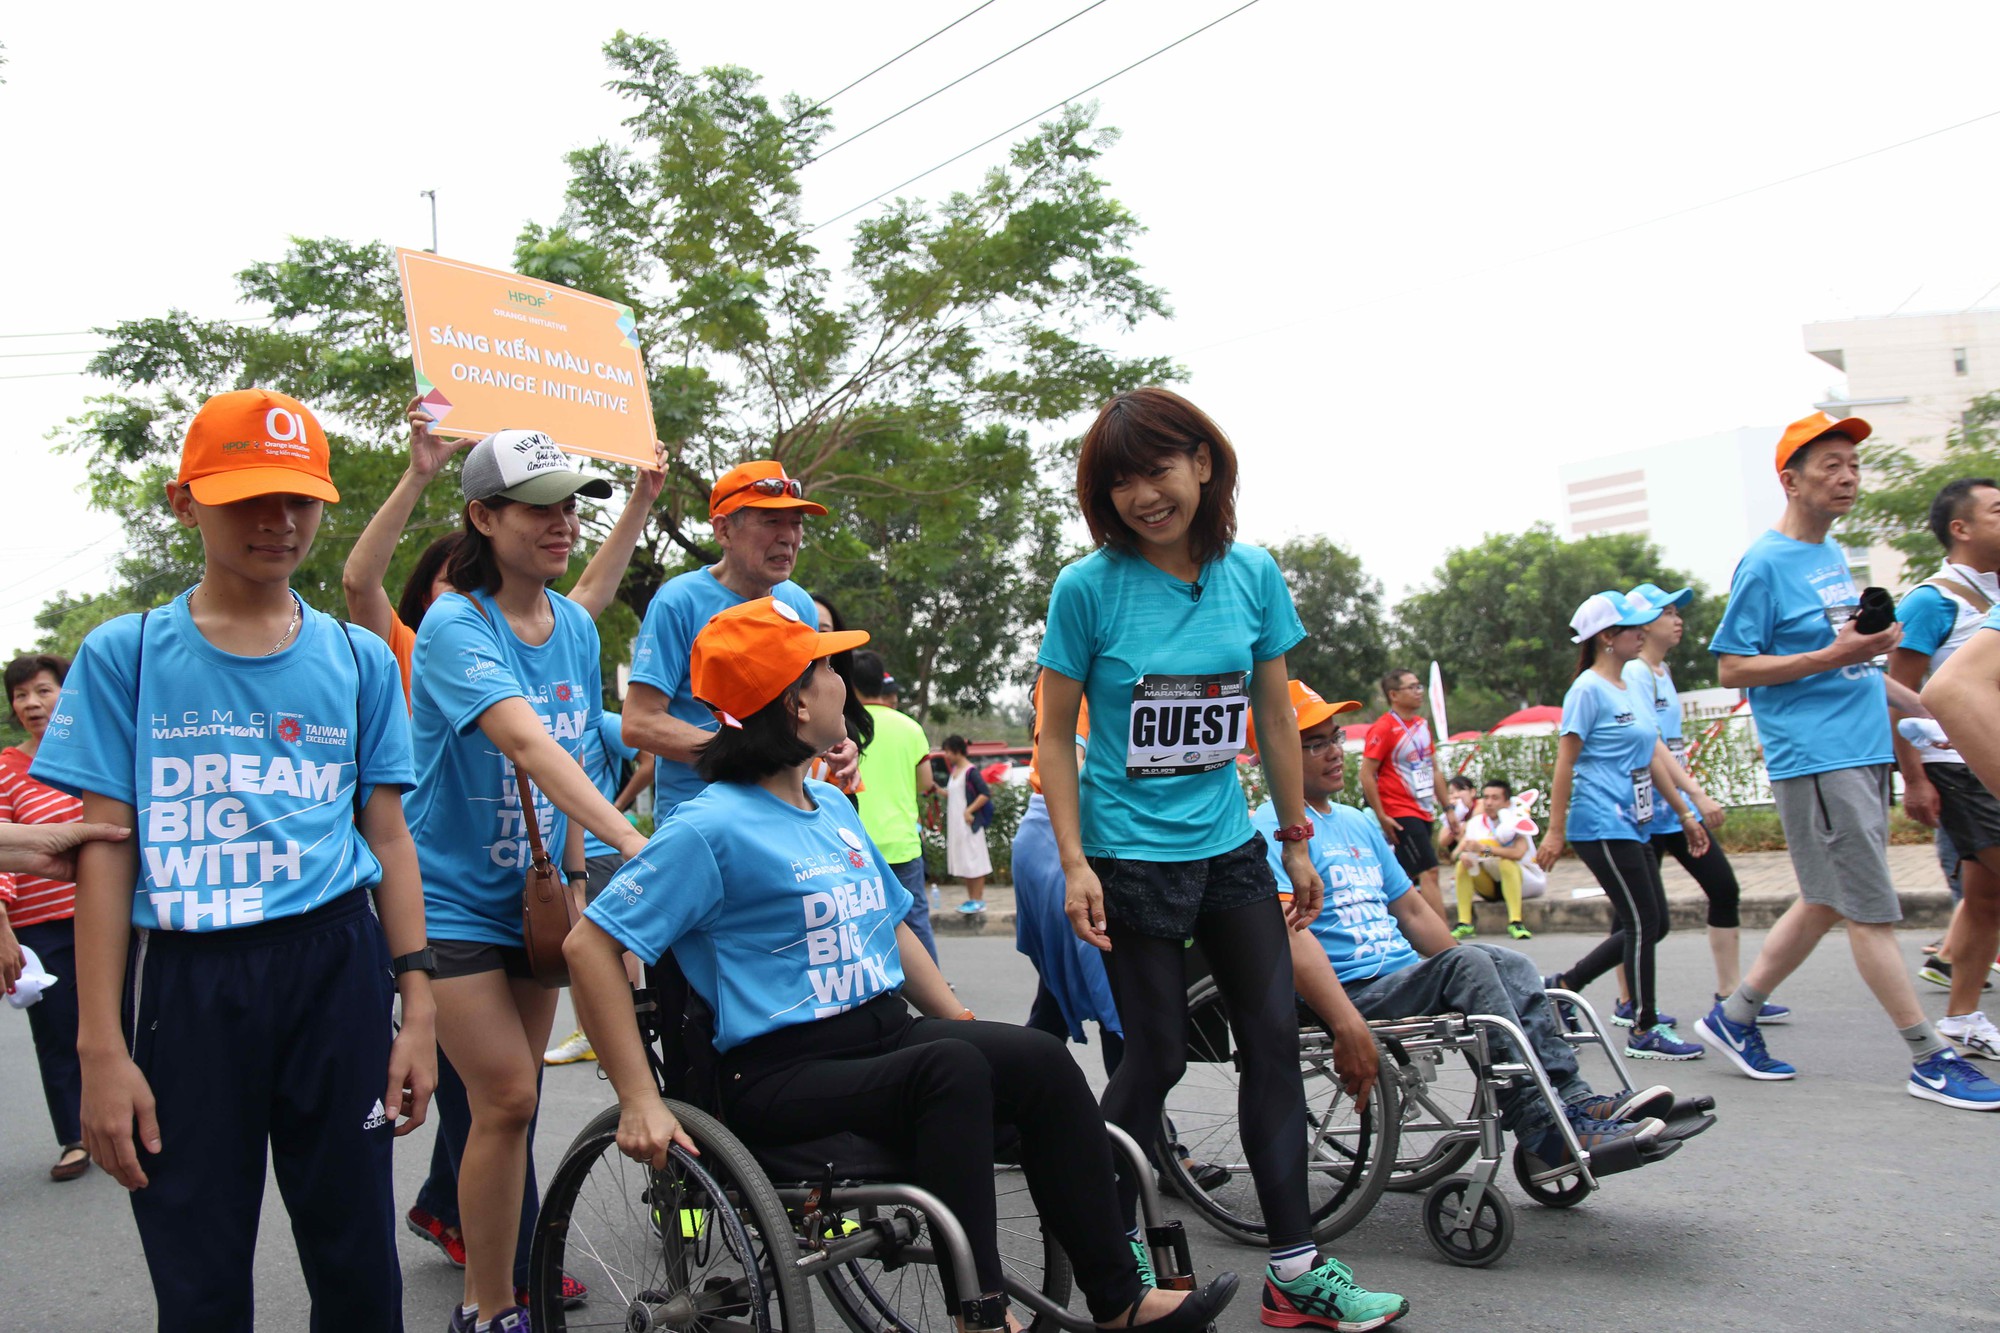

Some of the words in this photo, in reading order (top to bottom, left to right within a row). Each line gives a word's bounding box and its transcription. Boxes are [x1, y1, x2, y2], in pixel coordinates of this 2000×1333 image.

[493, 308, 529, 322] ORANGE
[529, 316, 568, 332] INITIATIVE
[508, 290, 546, 307] HPDF
[429, 325, 490, 353] SÁNG
[494, 337, 541, 364] KIẾN
[545, 350, 590, 375] MÀU
[594, 362, 635, 386] CAM
[451, 363, 537, 394] ORANGE
[542, 380, 629, 414] INITIATIVE
[513, 434, 541, 454] NEW
[152, 724, 265, 740] MARATHON
[305, 724, 348, 739] TAIWAN
[305, 736, 347, 746] EXCELLENCE
[1132, 702, 1245, 748] GUEST
[151, 754, 342, 802] DREAM
[149, 797, 249, 843] BIG
[145, 840, 301, 888] WITH
[150, 887, 264, 931] THE
[807, 922, 864, 966] BIG
